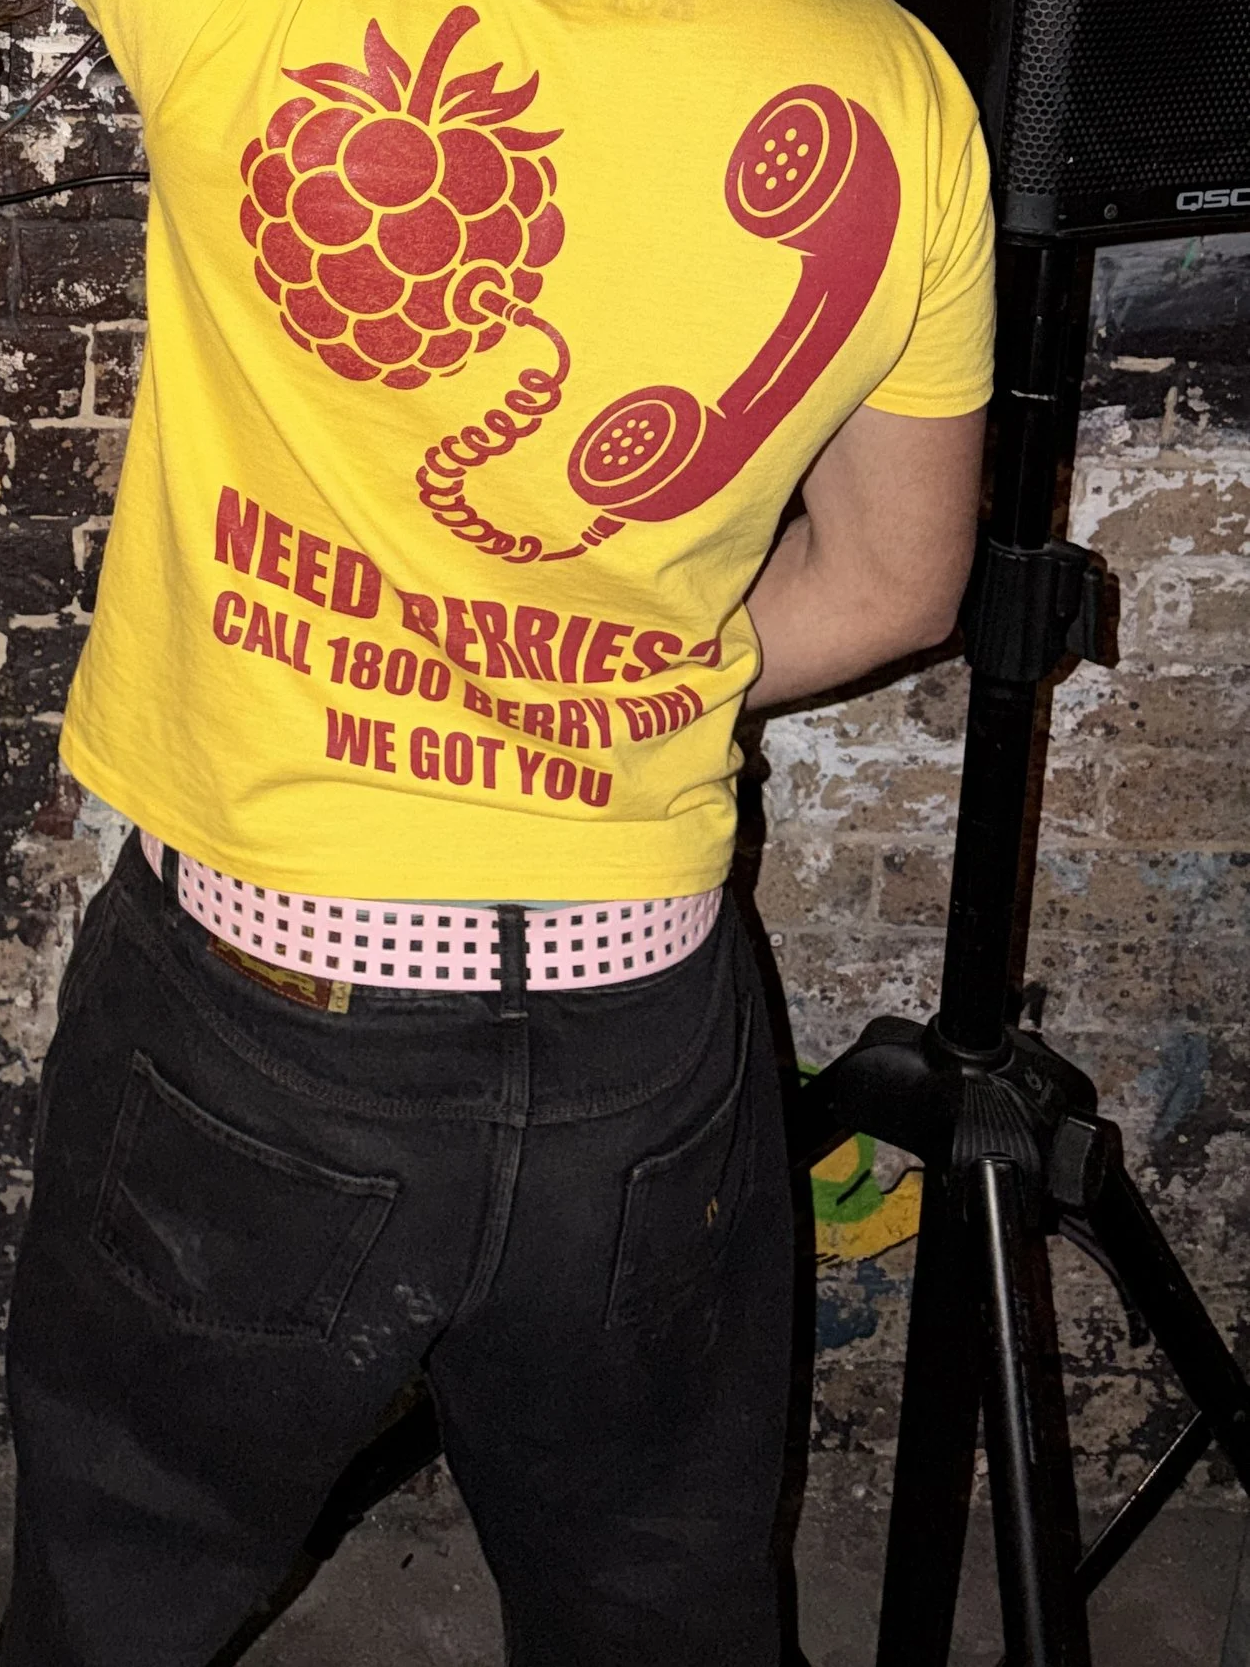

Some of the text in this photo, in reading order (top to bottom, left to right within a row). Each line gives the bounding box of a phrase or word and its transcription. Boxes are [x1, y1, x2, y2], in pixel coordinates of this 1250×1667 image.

[1176, 187, 1250, 212] QSC
[213, 484, 383, 620] NEED
[212, 589, 312, 675] CALL
[325, 636, 451, 702] 1800
[463, 680, 613, 749] BERRY
[324, 706, 614, 808] WE GOT YOU
